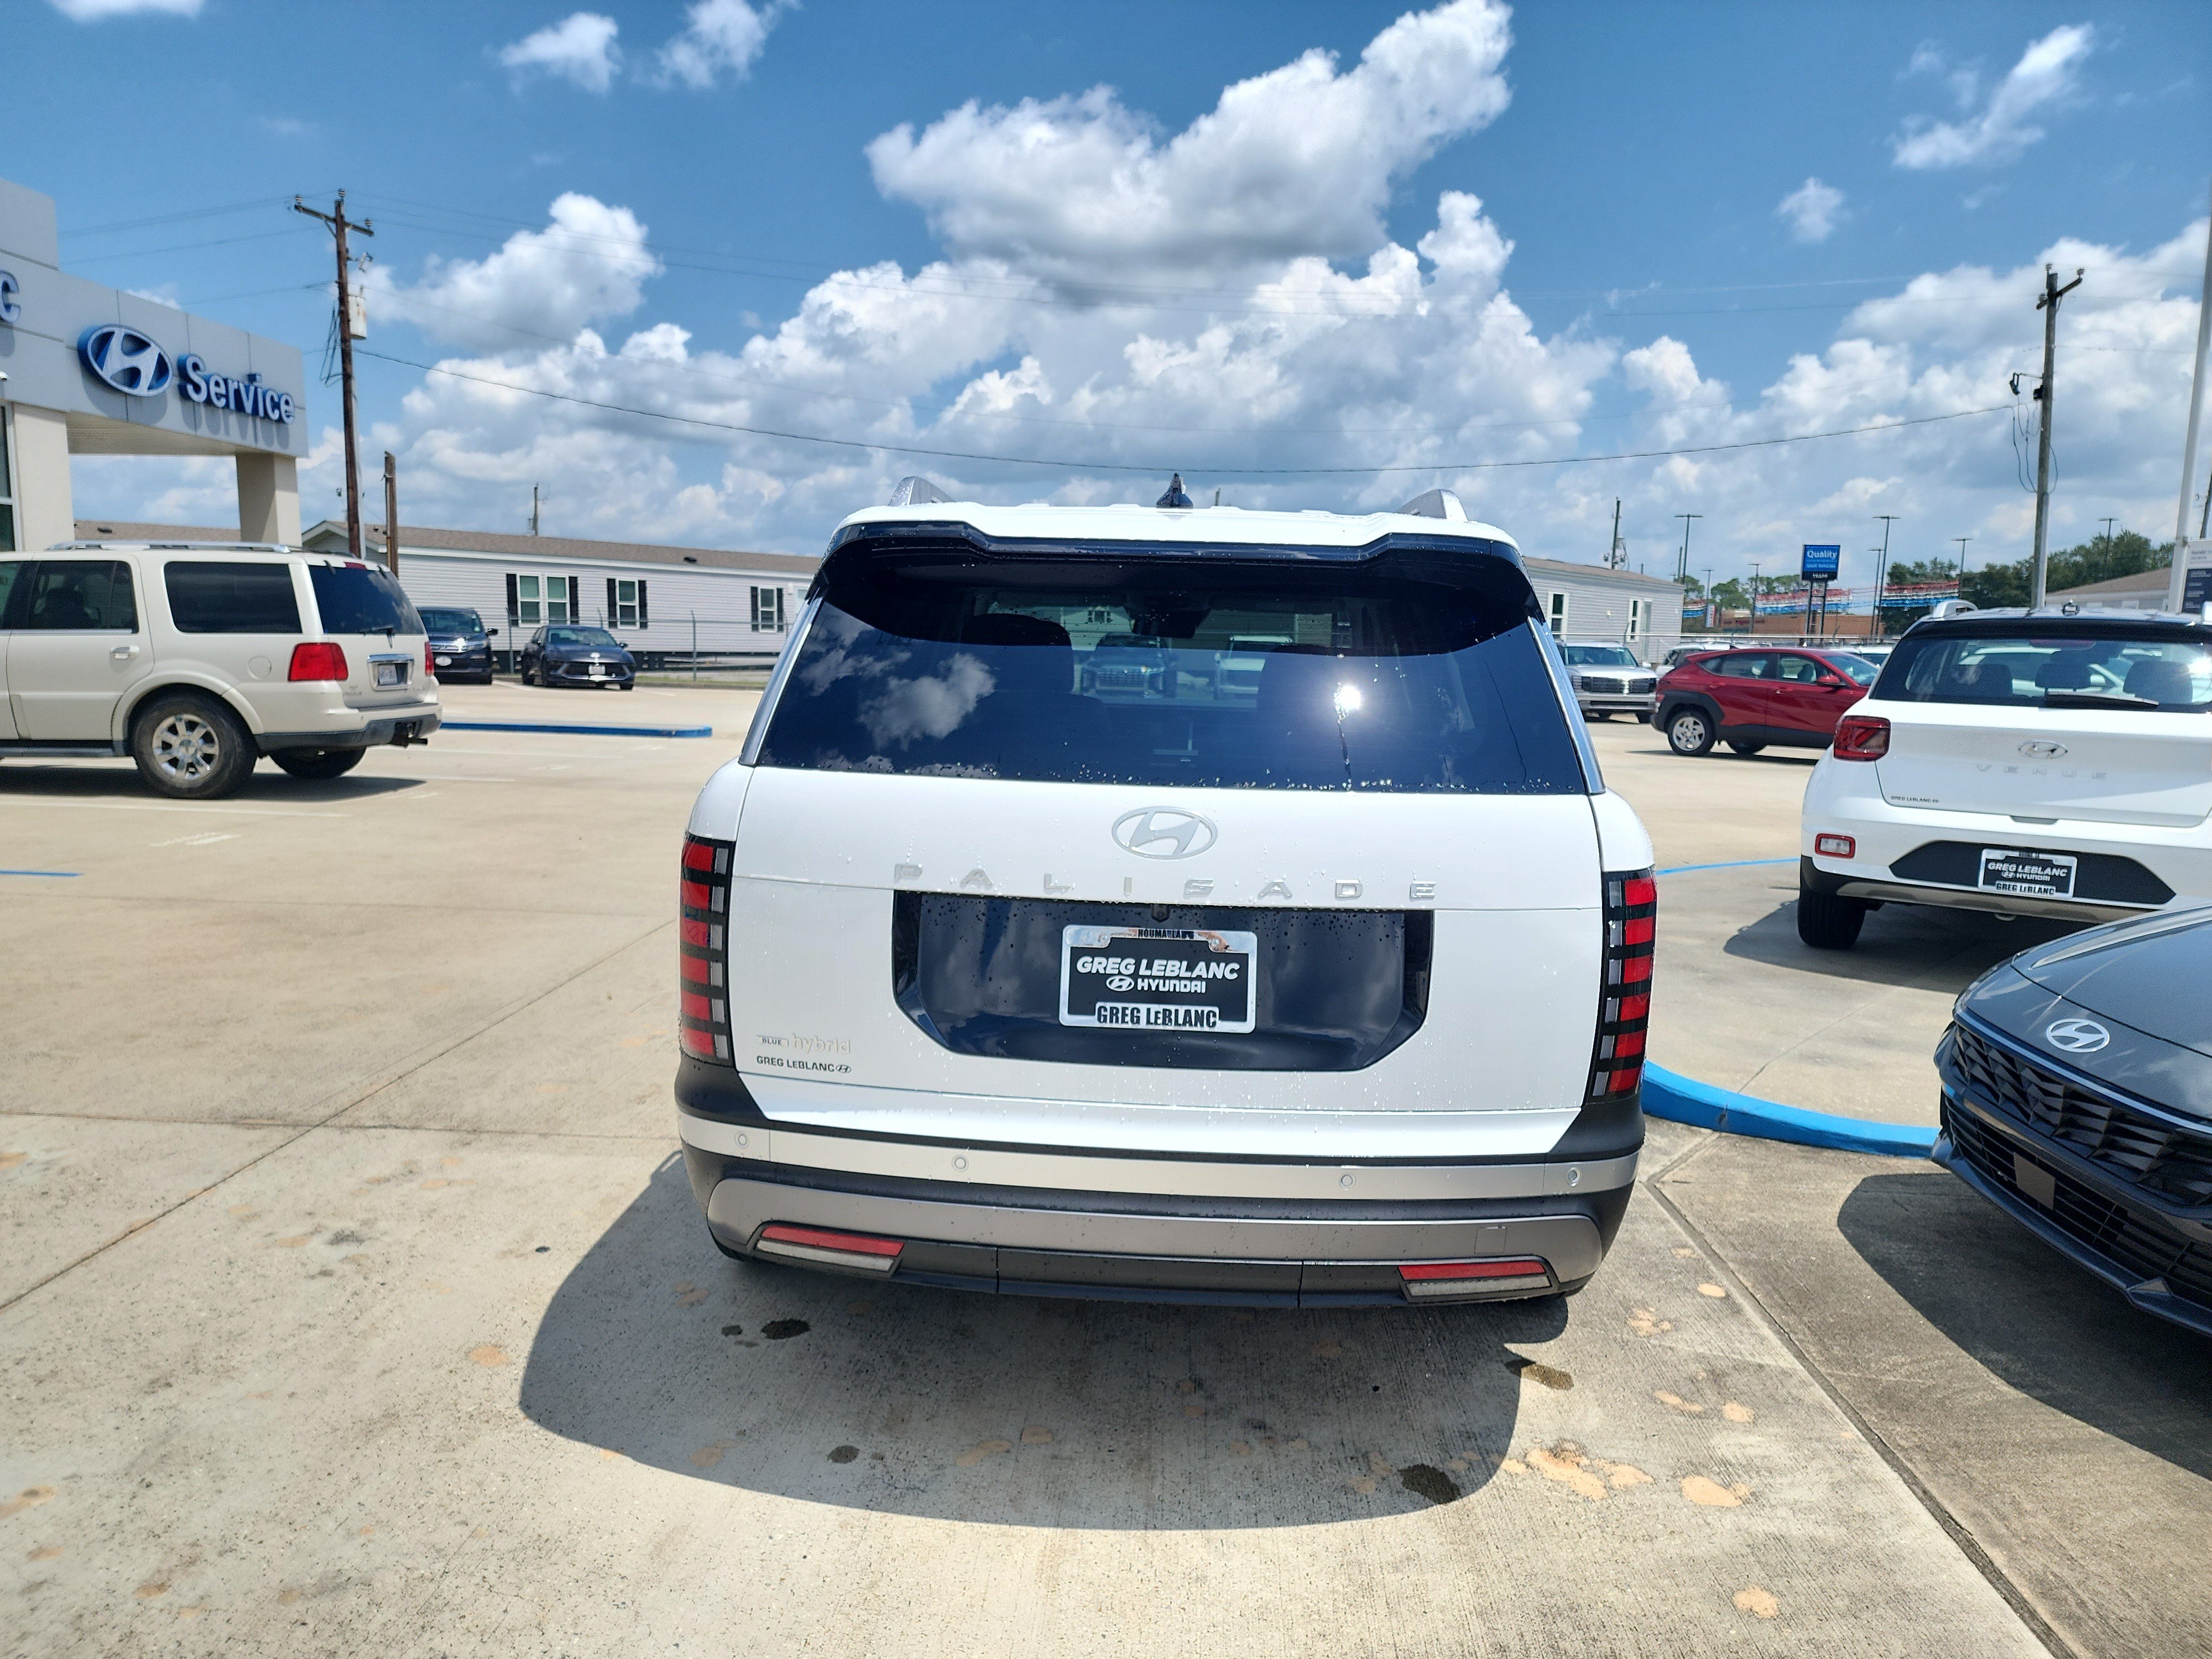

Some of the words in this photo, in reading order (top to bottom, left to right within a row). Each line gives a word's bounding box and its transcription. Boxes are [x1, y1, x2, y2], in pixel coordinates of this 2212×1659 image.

[180, 352, 296, 425] Service
[1807, 549, 1838, 560] Quality
[1976, 763, 2106, 780] VENUE
[1987, 862, 2016, 872] GREG
[2018, 864, 2068, 877] LEBLANC
[2016, 873, 2051, 881] HYUNDAI
[894, 863, 1437, 900] PALISADE
[1996, 883, 2018, 891] GREG
[1077, 956, 1135, 975] GREG
[1139, 959, 1240, 980] LEBLANC
[1137, 978, 1206, 994] HYUNDAI
[1097, 1005, 1140, 1025] GREG
[761, 1037, 782, 1046] BLUE
[792, 1033, 851, 1054] hybrid
[757, 1055, 784, 1067] GREG
